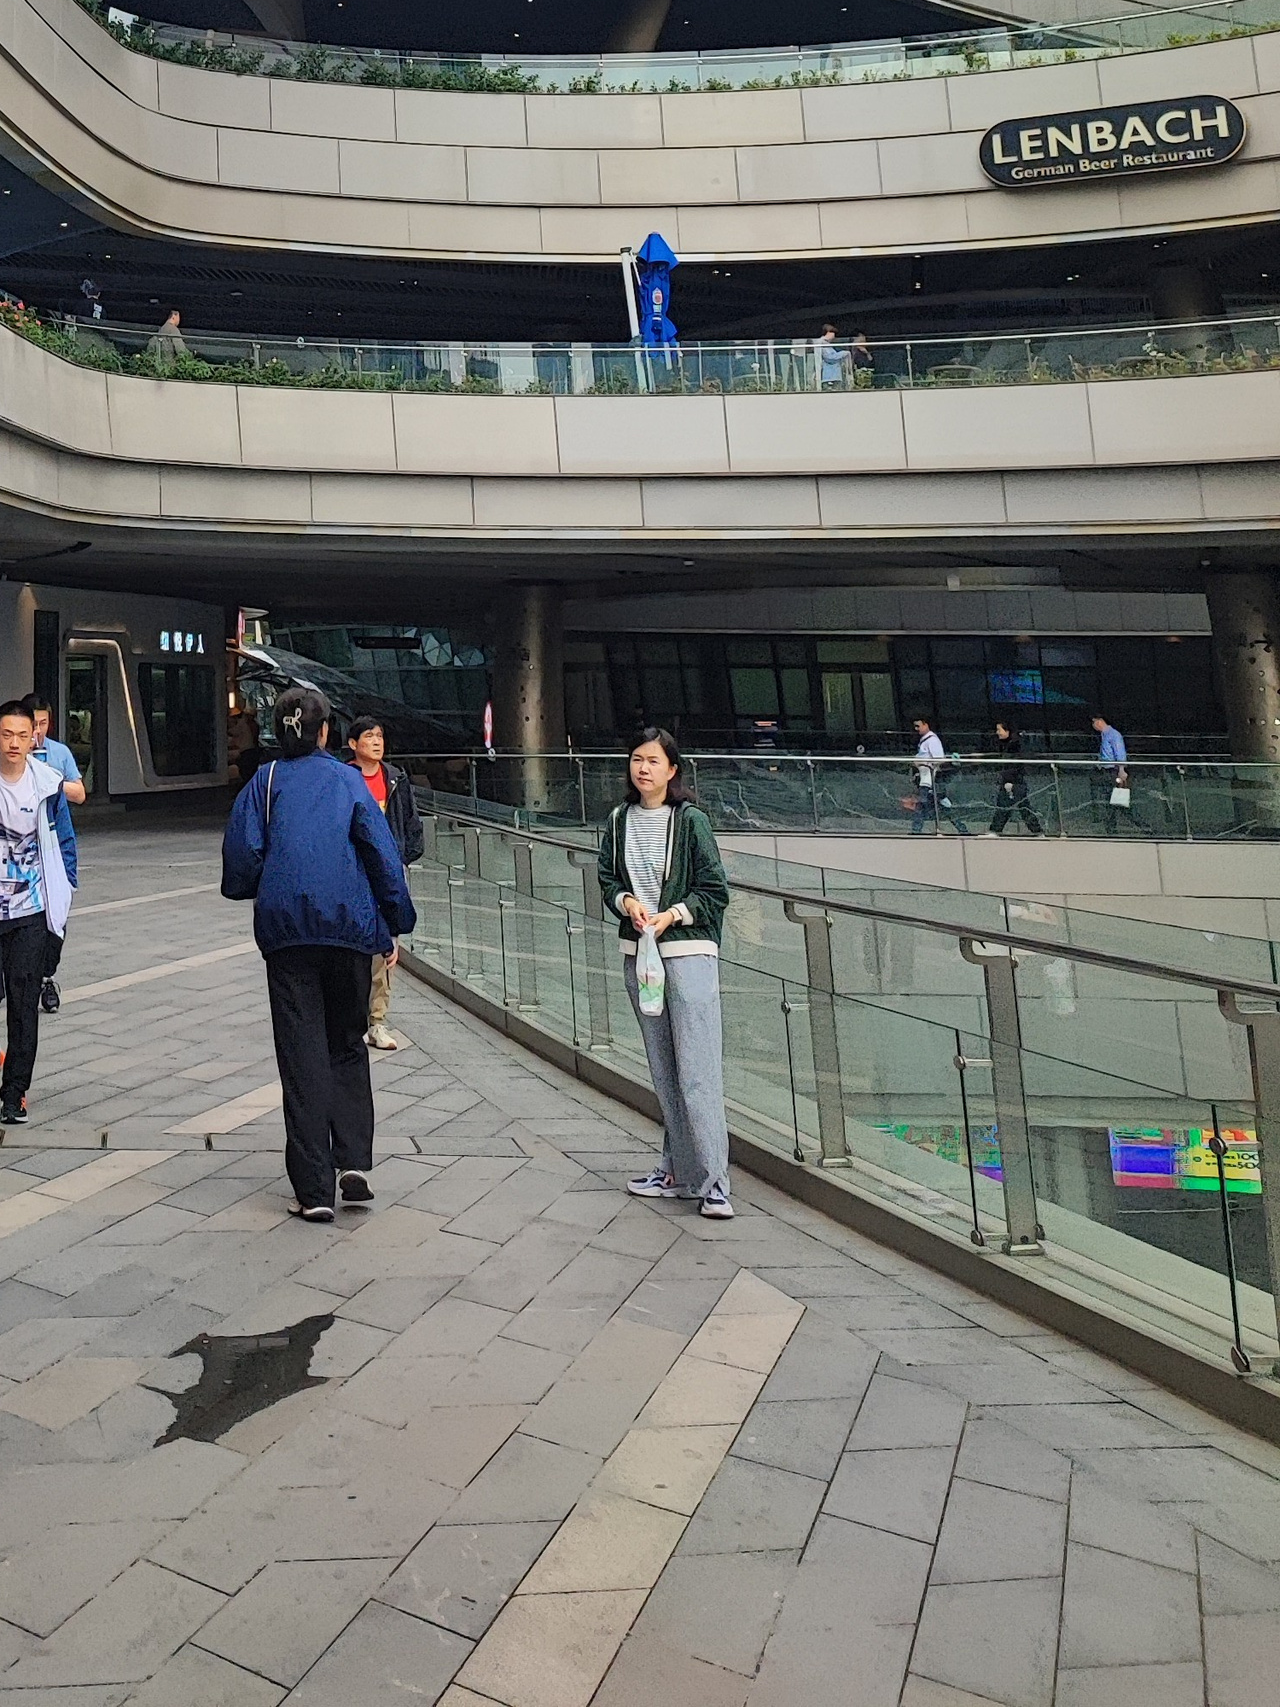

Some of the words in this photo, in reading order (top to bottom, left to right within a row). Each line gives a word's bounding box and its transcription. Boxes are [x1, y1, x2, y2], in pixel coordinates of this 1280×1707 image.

[991, 105, 1231, 165] LENBACH
[1011, 162, 1074, 181] German
[1079, 158, 1118, 173] Beer
[1122, 146, 1215, 168] Restaurant
